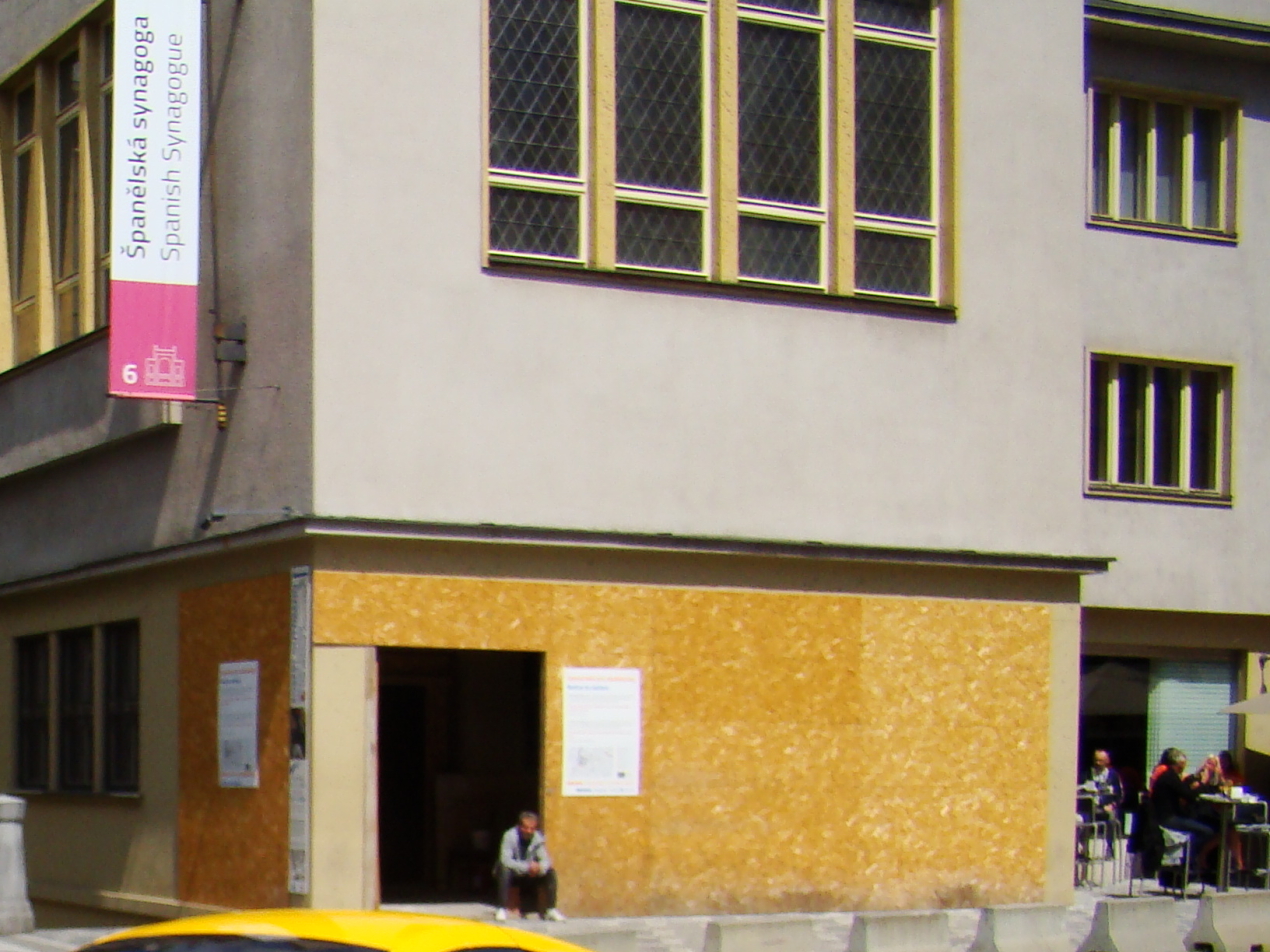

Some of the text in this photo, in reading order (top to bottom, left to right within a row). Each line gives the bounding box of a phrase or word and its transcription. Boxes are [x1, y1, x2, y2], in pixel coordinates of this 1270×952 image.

[120, 16, 155, 259] Španělská synagoga
[160, 33, 189, 261] Spanish Synagogue
[122, 364, 139, 385] 6
